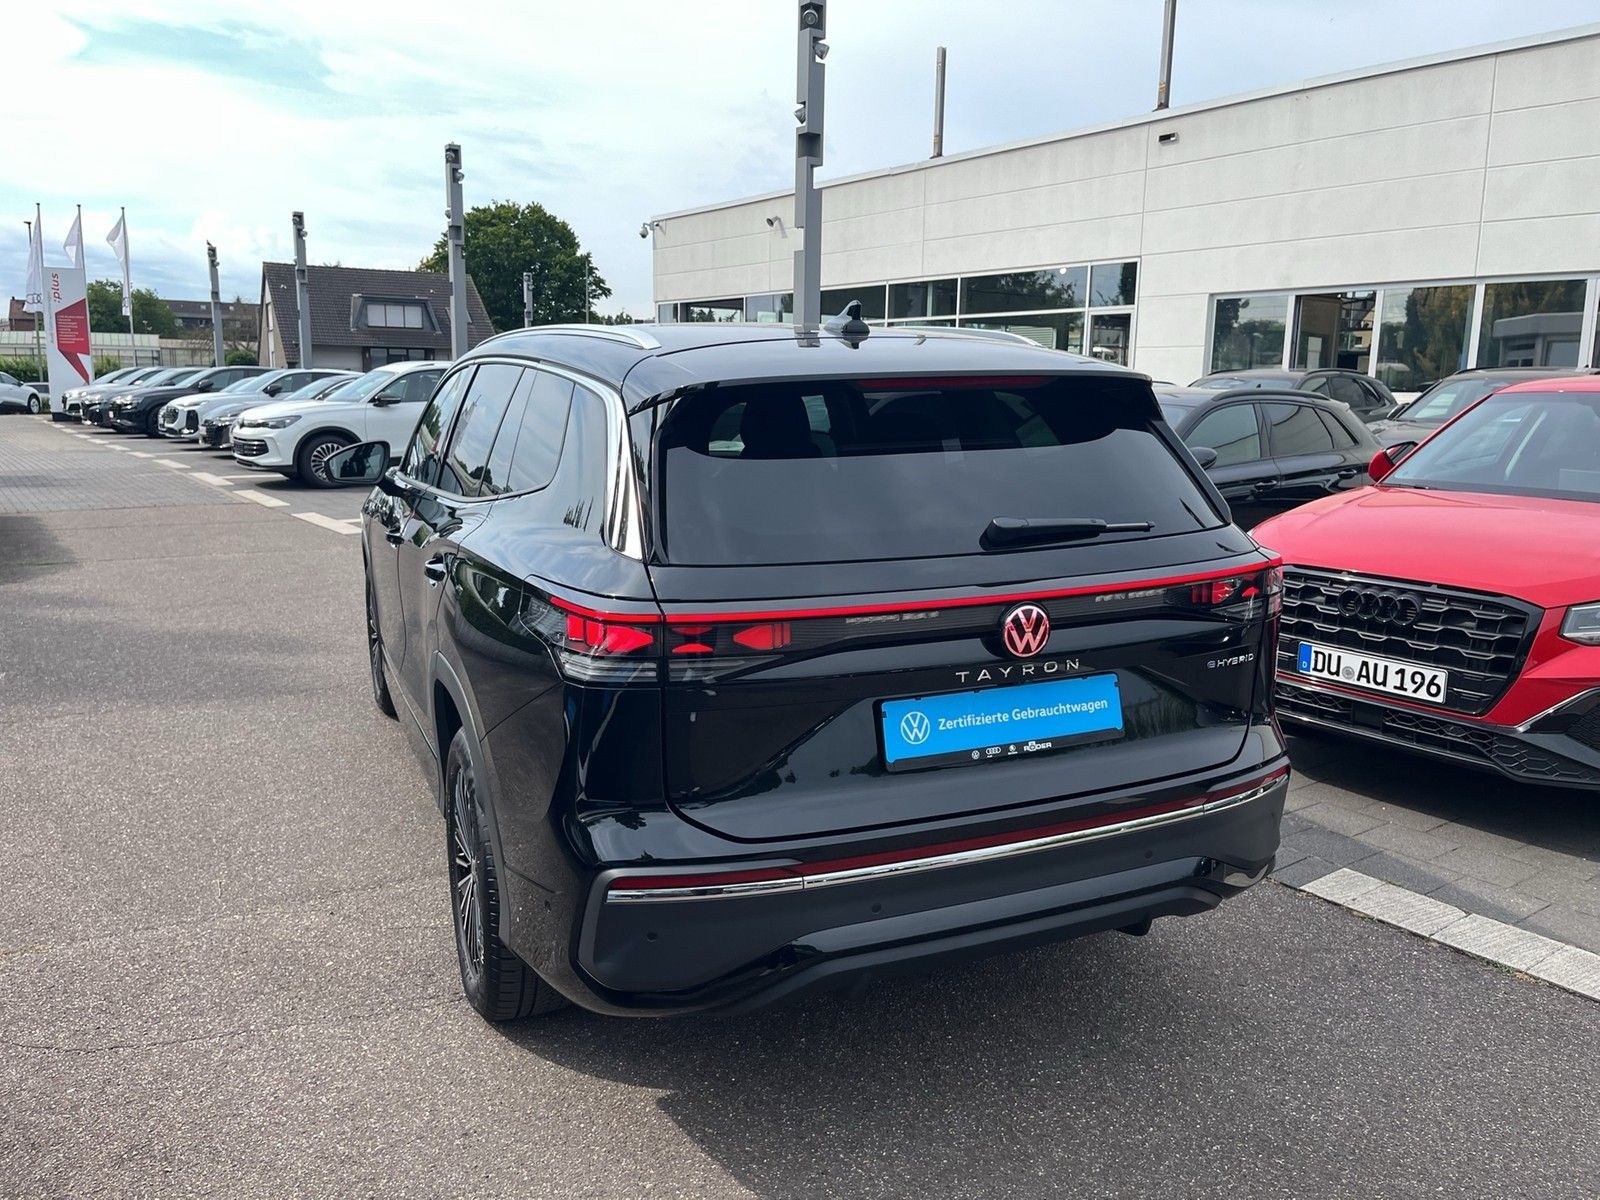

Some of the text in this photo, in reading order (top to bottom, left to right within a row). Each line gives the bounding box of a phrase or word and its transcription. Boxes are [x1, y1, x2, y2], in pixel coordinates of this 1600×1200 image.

[955, 659, 1079, 683] TAYRON
[1312, 650, 1442, 698] DU AU 196
[900, 711, 931, 745] VW
[938, 698, 1108, 731] Zertifizierte Gebrauchtwagen
